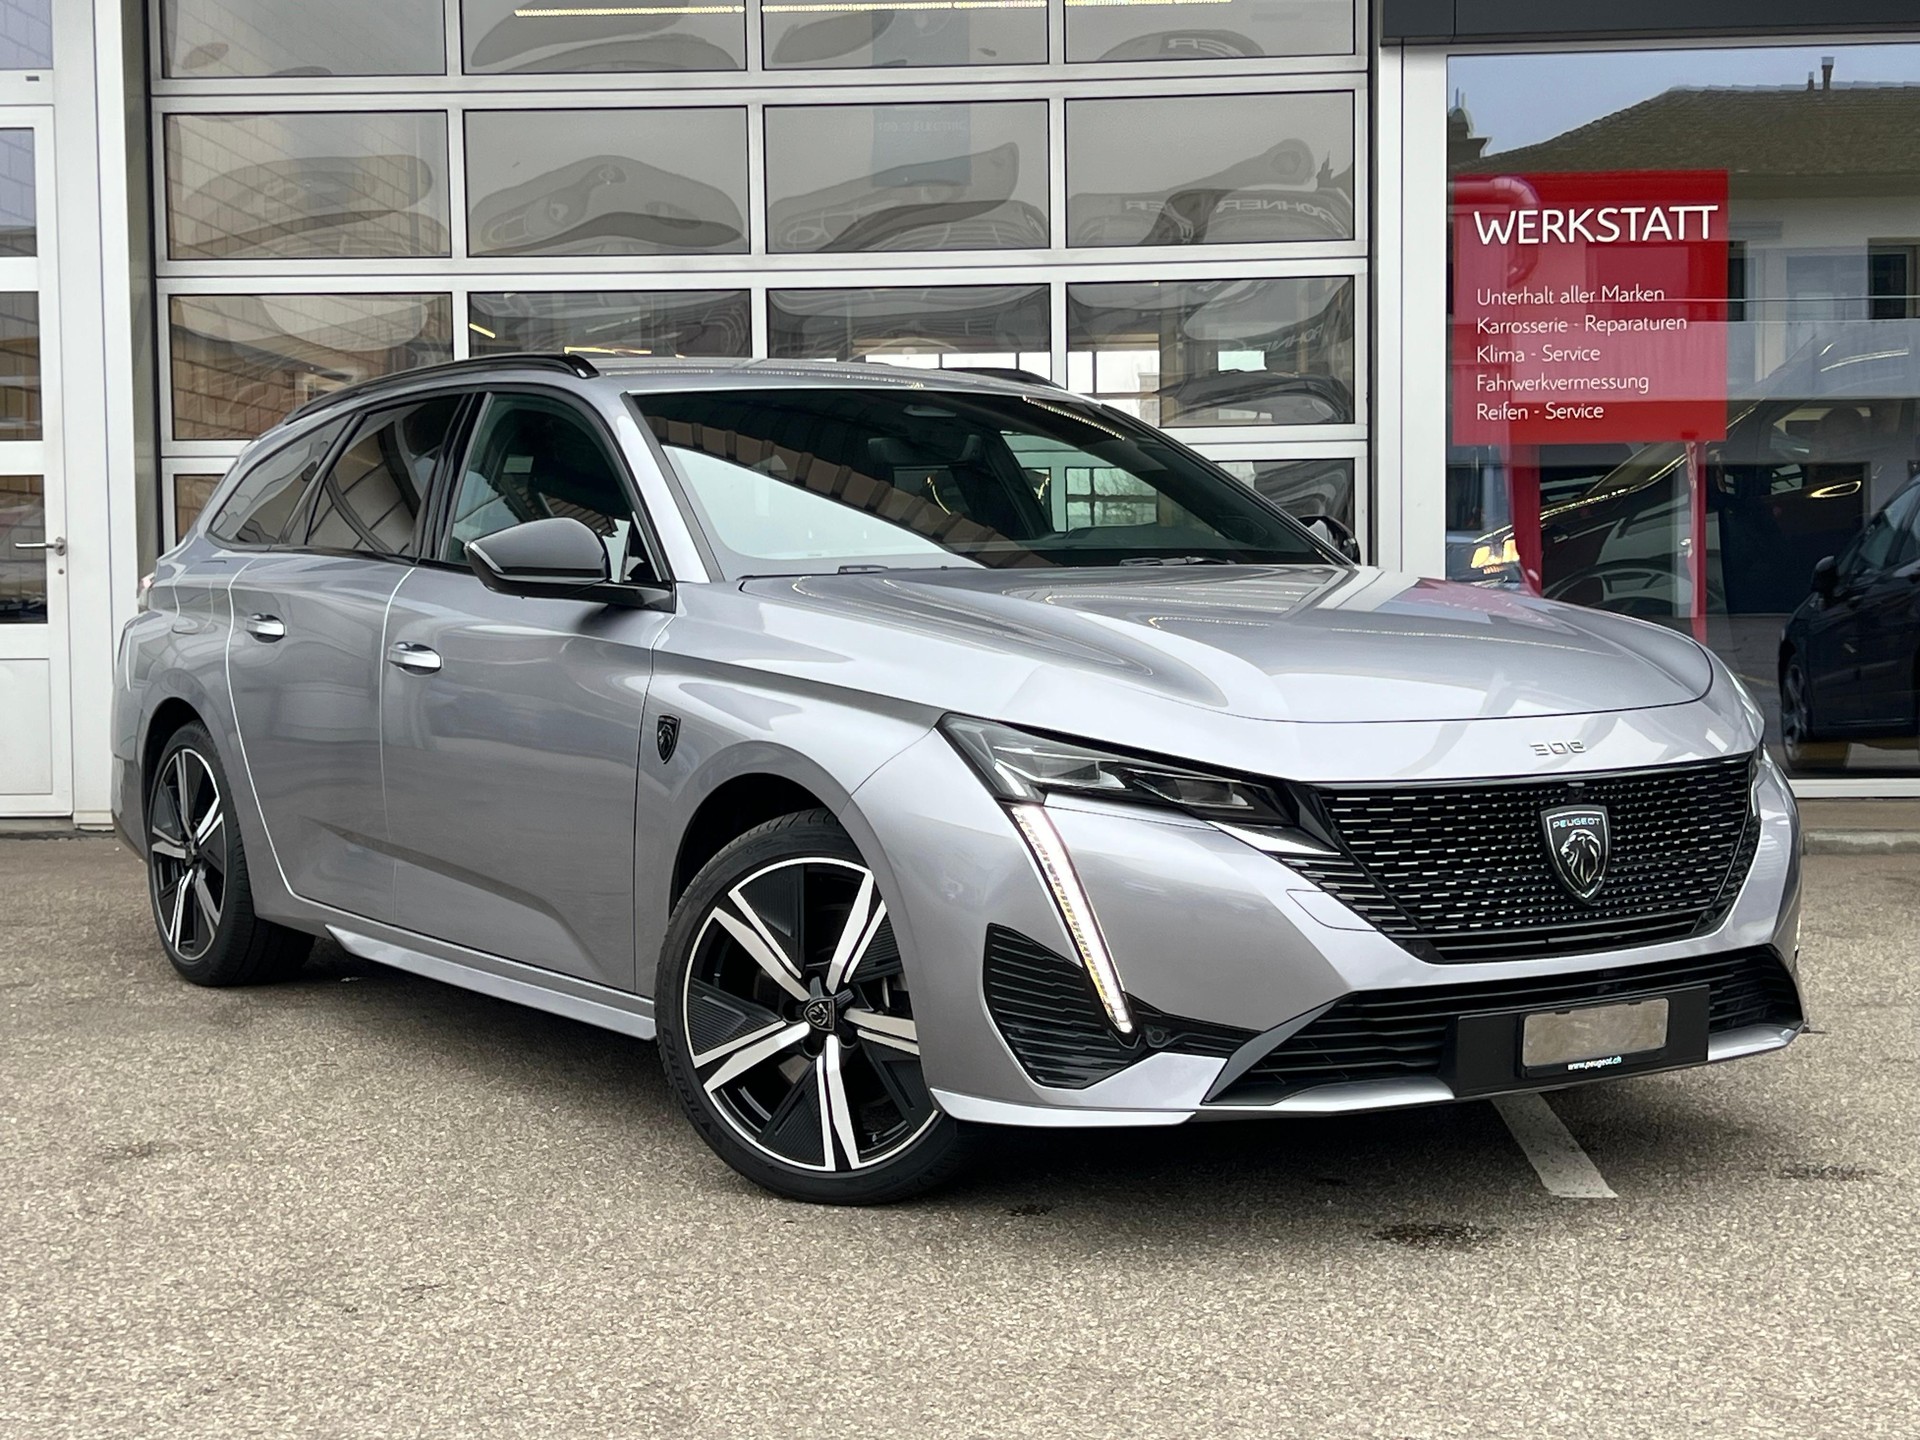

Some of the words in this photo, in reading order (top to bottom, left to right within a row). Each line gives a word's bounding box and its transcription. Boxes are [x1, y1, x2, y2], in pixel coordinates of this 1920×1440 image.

[1474, 205, 1718, 244] WERKSTATT
[1477, 286, 1554, 305] Unterhalt
[1560, 285, 1595, 304] aller
[1602, 284, 1664, 303] Marken
[1477, 317, 1568, 334] Karrosserie
[1585, 315, 1686, 335] Reparaturen
[1477, 346, 1524, 362] Klima
[1542, 344, 1600, 362] Service
[1477, 373, 1649, 393] Fahrwerkvermessung
[1477, 402, 1528, 420] Reifen
[1545, 401, 1604, 419] Service
[1530, 741, 1586, 756] 308
[1553, 817, 1600, 829] PEUGEOT
